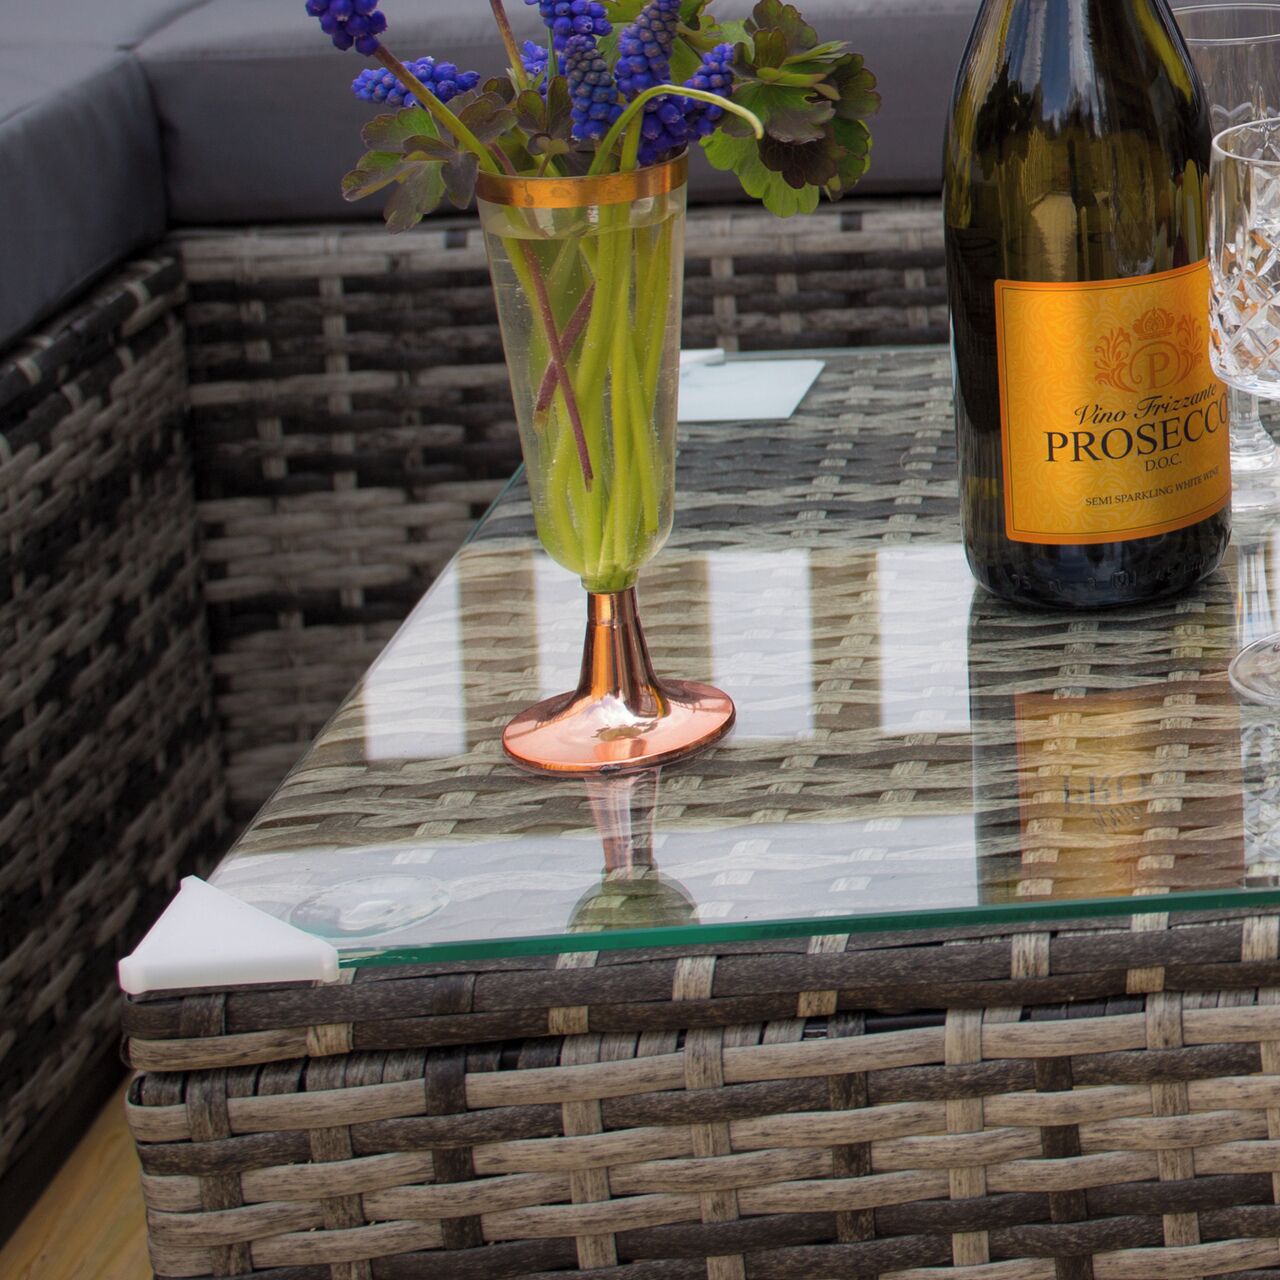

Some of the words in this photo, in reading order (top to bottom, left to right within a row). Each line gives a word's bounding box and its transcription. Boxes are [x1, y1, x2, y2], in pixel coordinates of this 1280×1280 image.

[1074, 404, 1127, 425] Vino
[1134, 383, 1217, 419] Frizzante
[1044, 392, 1228, 462] PROSECCO
[1145, 453, 1182, 472] D.O.C.
[1085, 496, 1112, 507] SEMI
[1115, 485, 1173, 505] SPARKLING
[1175, 477, 1203, 491] WHITE
